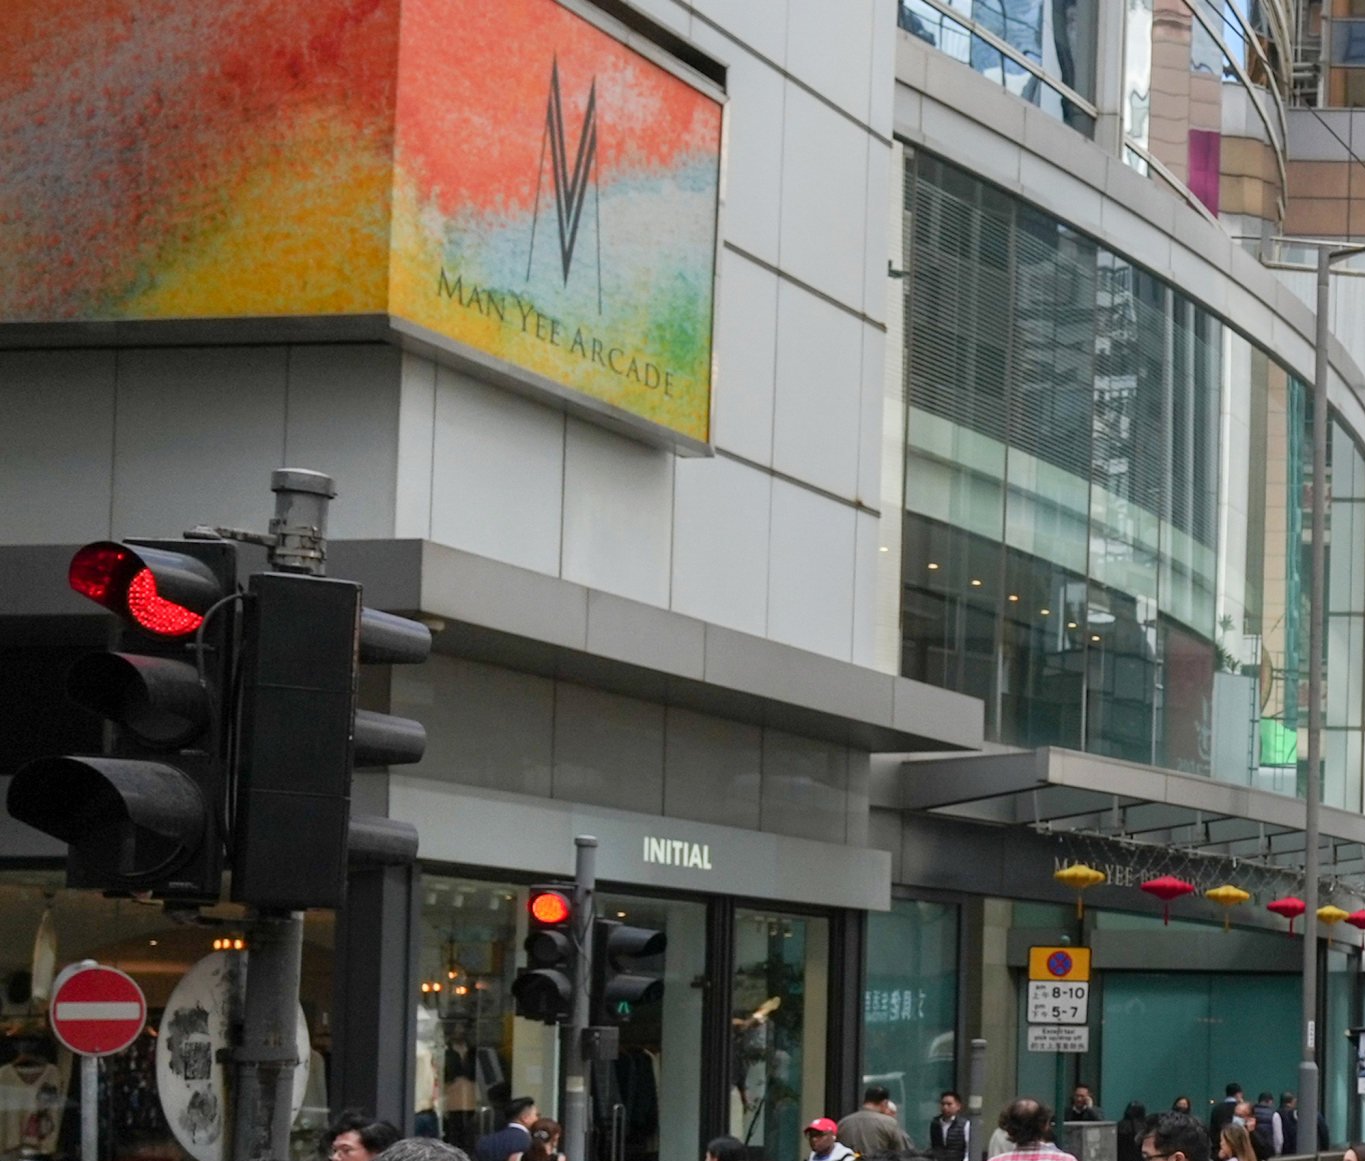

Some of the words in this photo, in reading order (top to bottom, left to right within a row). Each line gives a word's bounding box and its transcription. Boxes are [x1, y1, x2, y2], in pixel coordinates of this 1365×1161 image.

[437, 266, 506, 322] MAN
[509, 291, 561, 347] YEE
[569, 327, 676, 398] ARCADE
[643, 836, 712, 870] INITIAL
